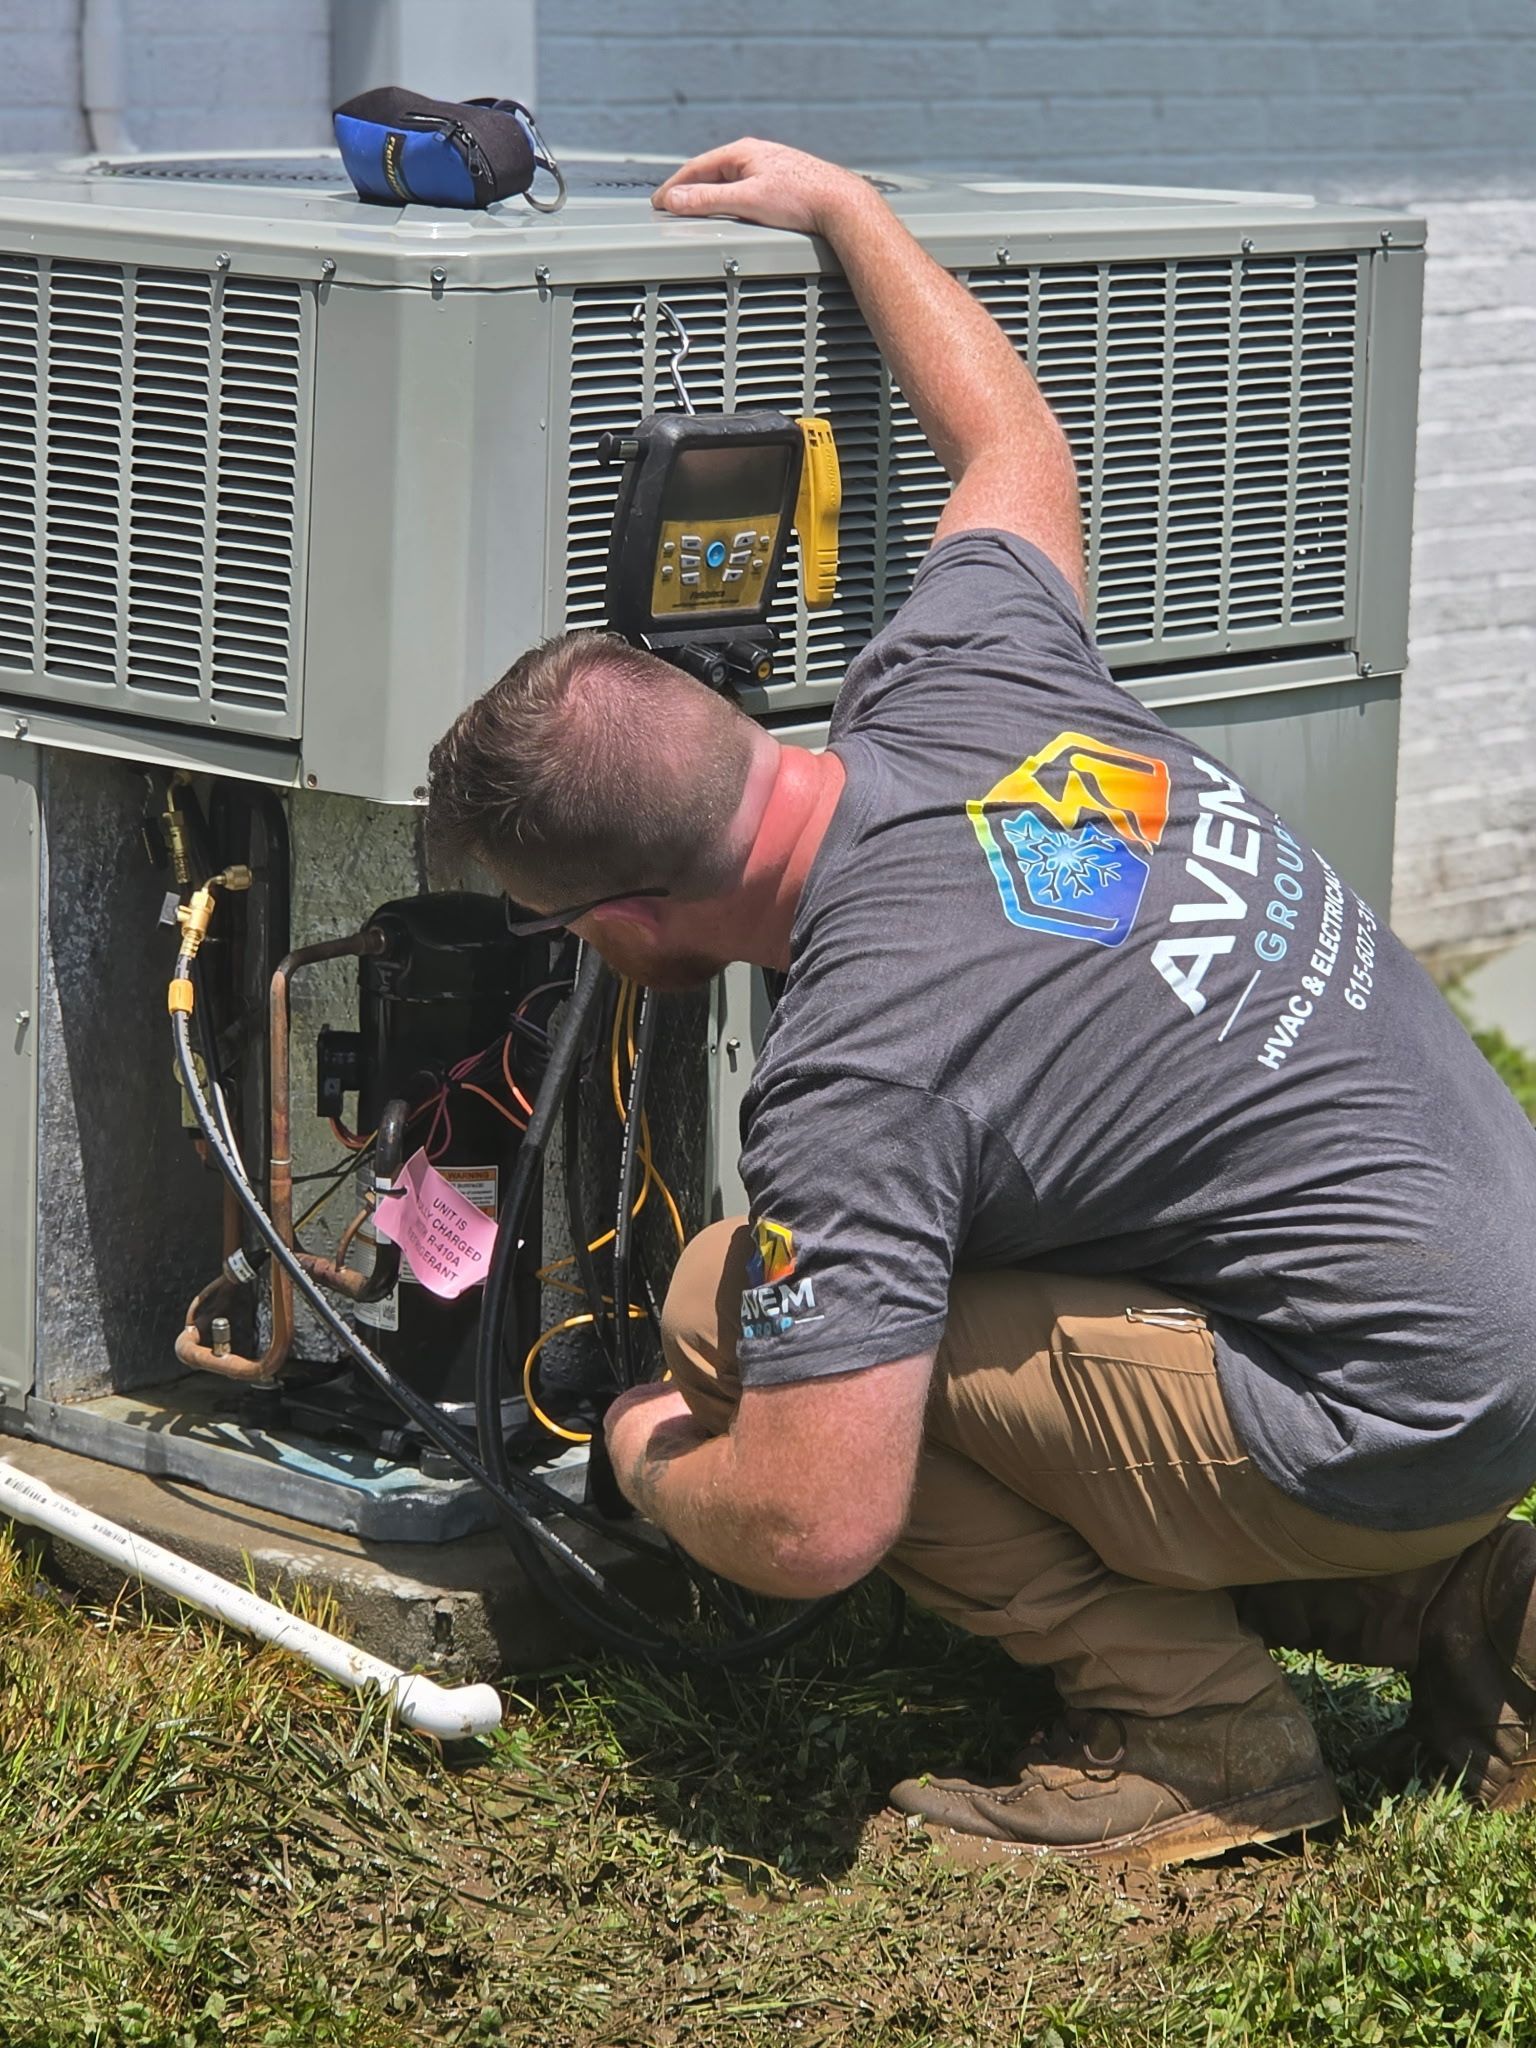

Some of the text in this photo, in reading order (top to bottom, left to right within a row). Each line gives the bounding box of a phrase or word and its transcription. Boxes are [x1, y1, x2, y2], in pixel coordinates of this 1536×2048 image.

[1151, 756, 1261, 1017] AVEM
[1254, 824, 1305, 963] GROUP
[1257, 996, 1314, 1071] HVAC
[1301, 976, 1327, 997] &
[432, 1217, 483, 1263] CHARGED
[433, 1197, 458, 1221] UNIT
[457, 1217, 468, 1232] IS
[427, 1235, 461, 1268] R-410A
